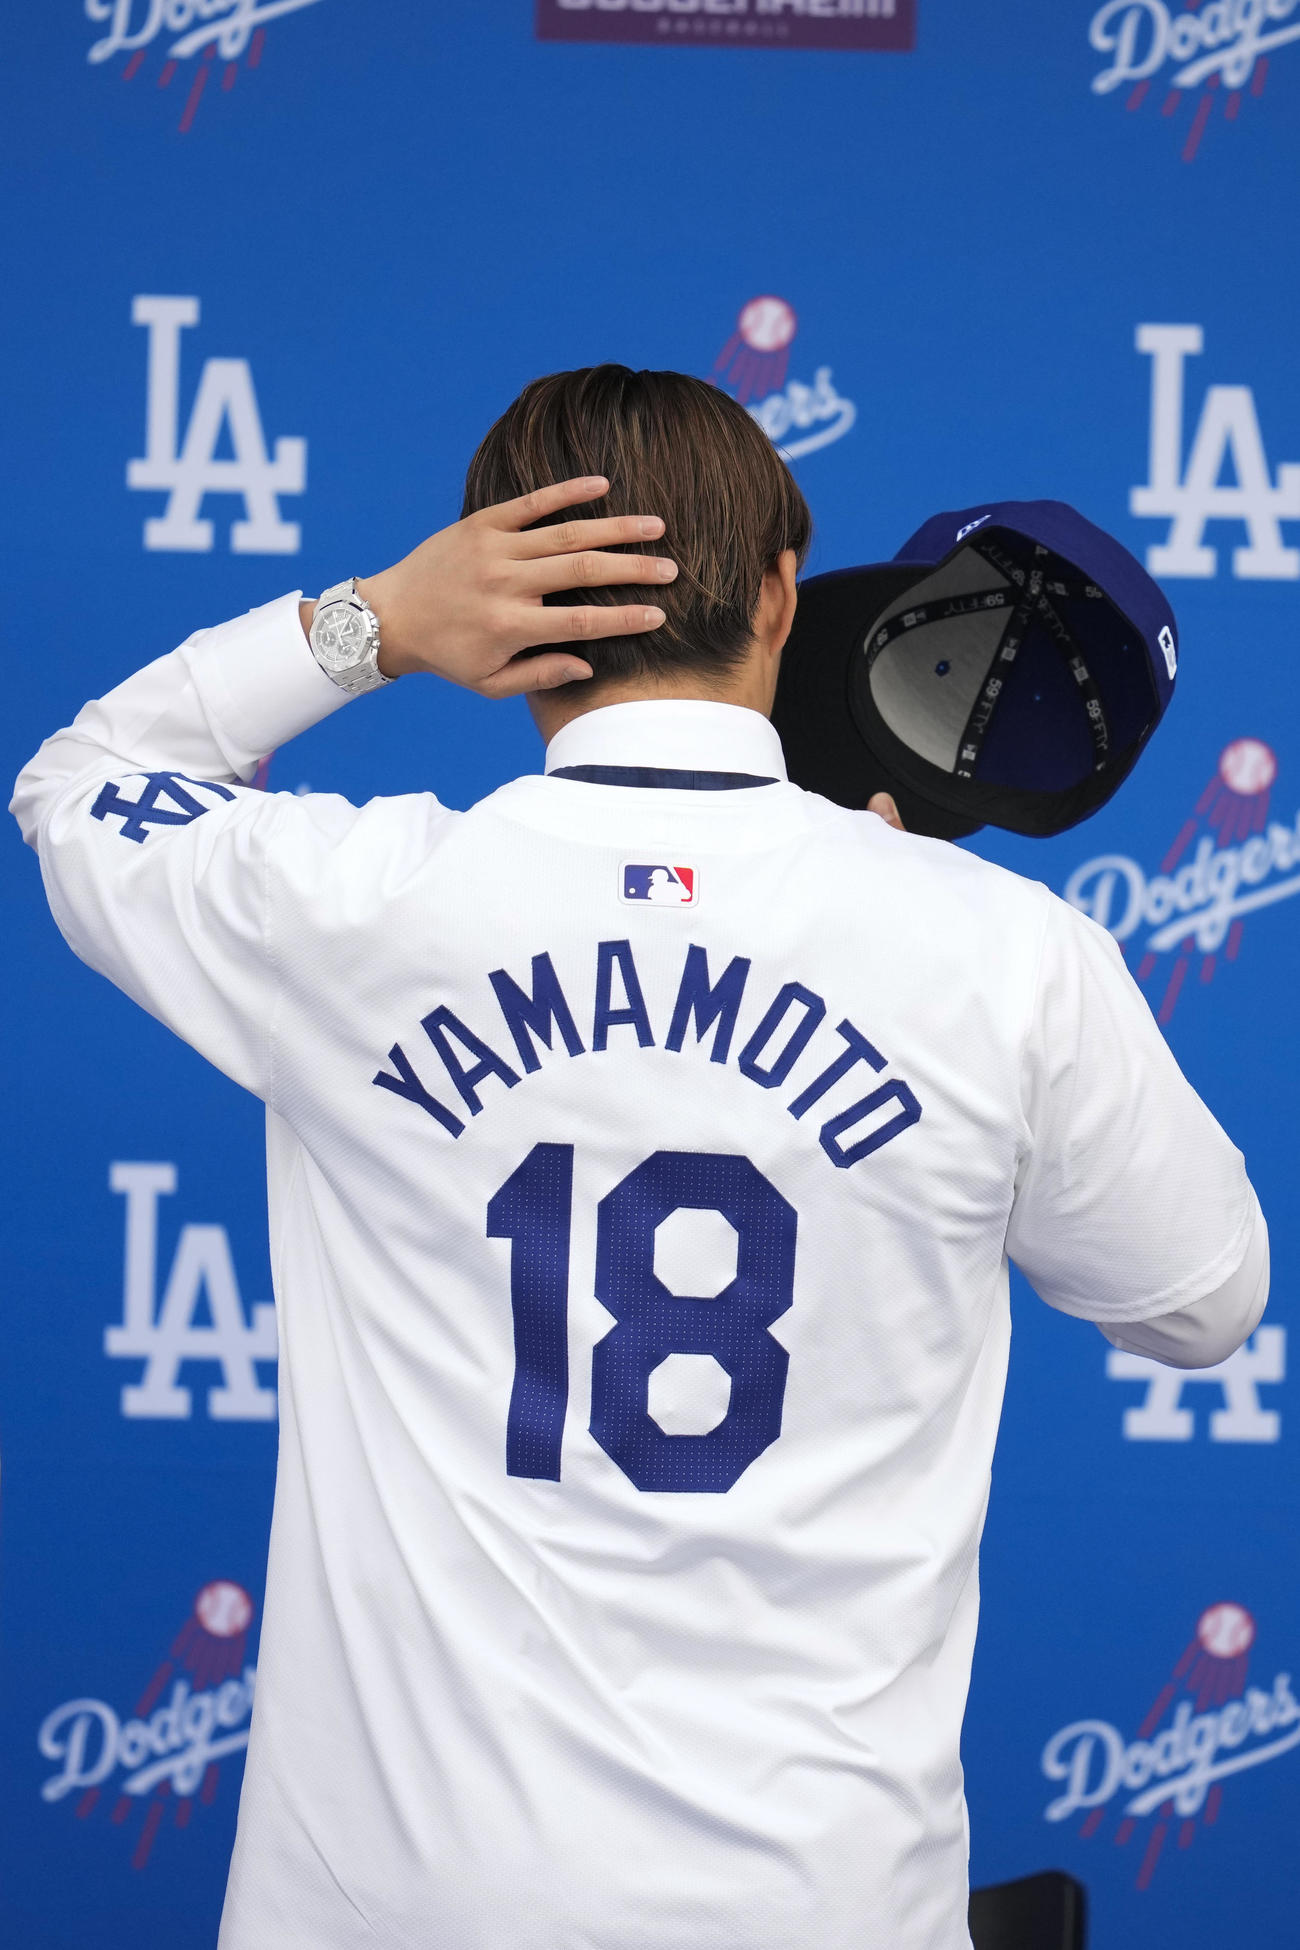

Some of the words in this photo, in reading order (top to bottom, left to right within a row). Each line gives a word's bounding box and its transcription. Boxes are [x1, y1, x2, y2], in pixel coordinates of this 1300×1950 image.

[126, 294, 307, 555] LA
[1130, 323, 1300, 580] LA
[1064, 810, 1300, 952] Dodger
[371, 938, 923, 1169] YAMAMOTO
[104, 1162, 280, 1421] LA
[486, 1141, 798, 1494] 18
[1041, 1672, 1300, 1823] Dodgers
